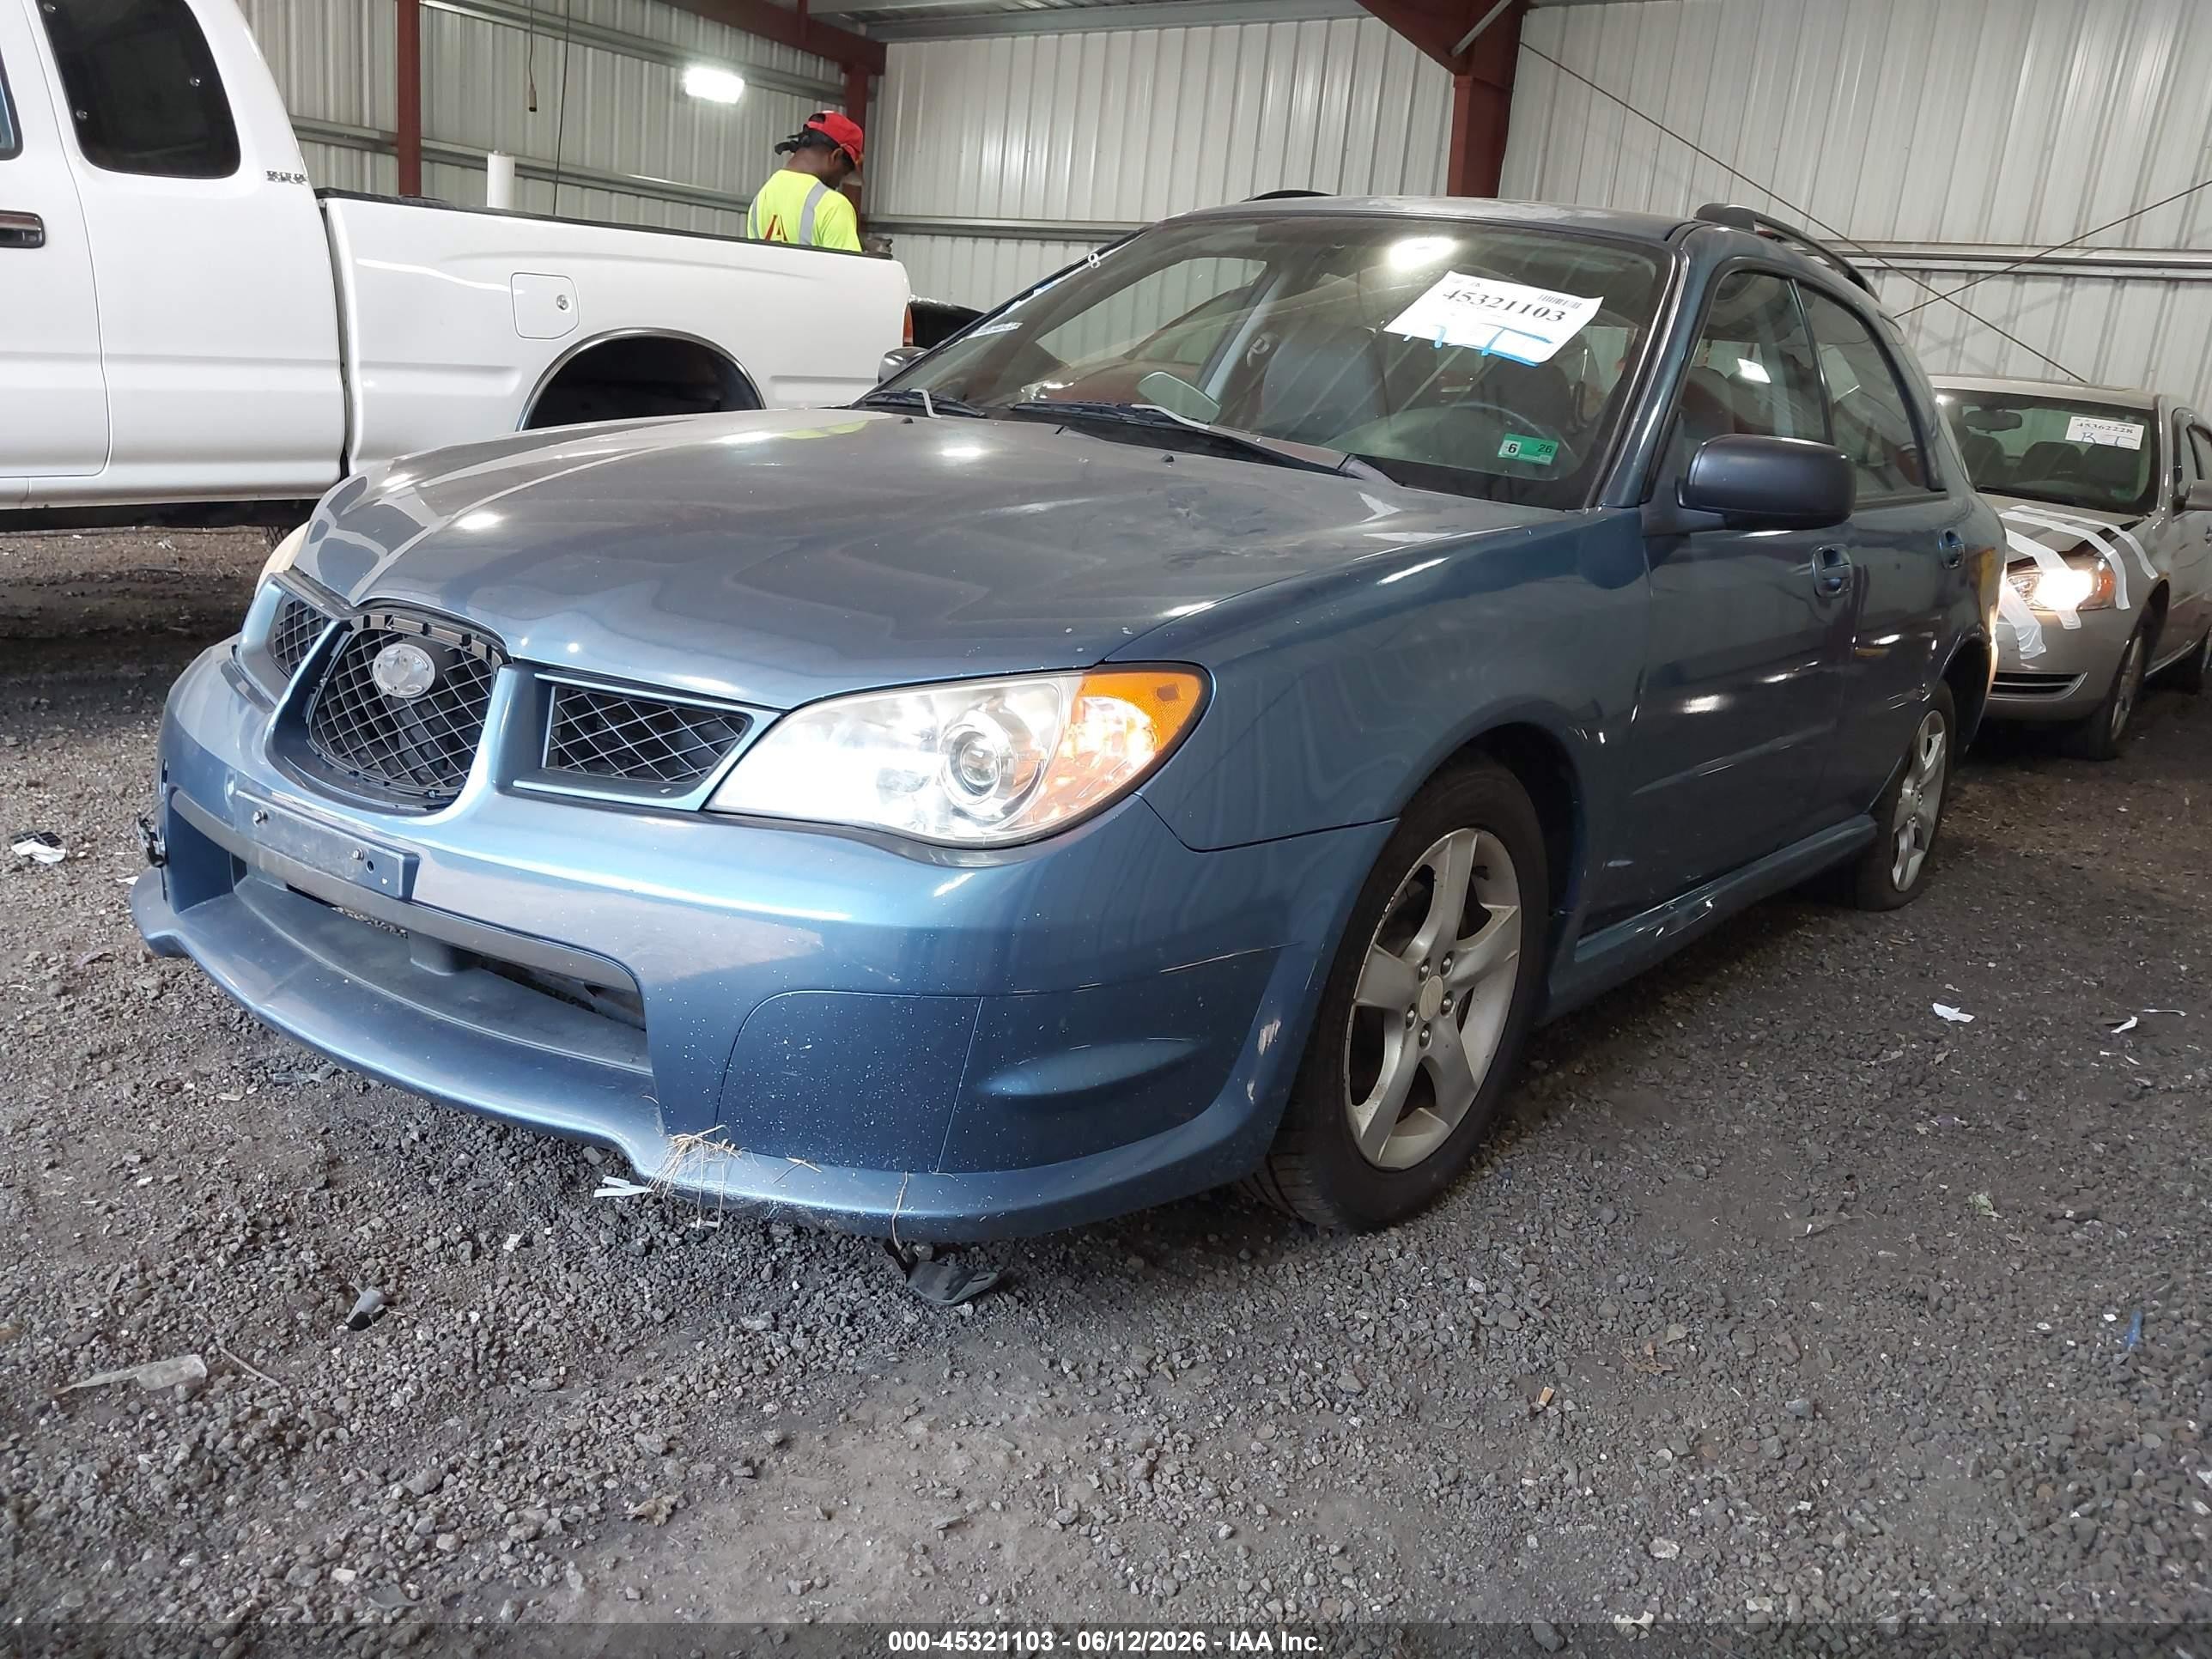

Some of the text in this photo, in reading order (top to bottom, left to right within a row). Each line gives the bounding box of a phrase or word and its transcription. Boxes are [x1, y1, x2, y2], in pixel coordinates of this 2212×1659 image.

[1443, 289, 1566, 322] 45321103
[1508, 443, 1518, 453] 6
[1538, 444, 1553, 453] 26
